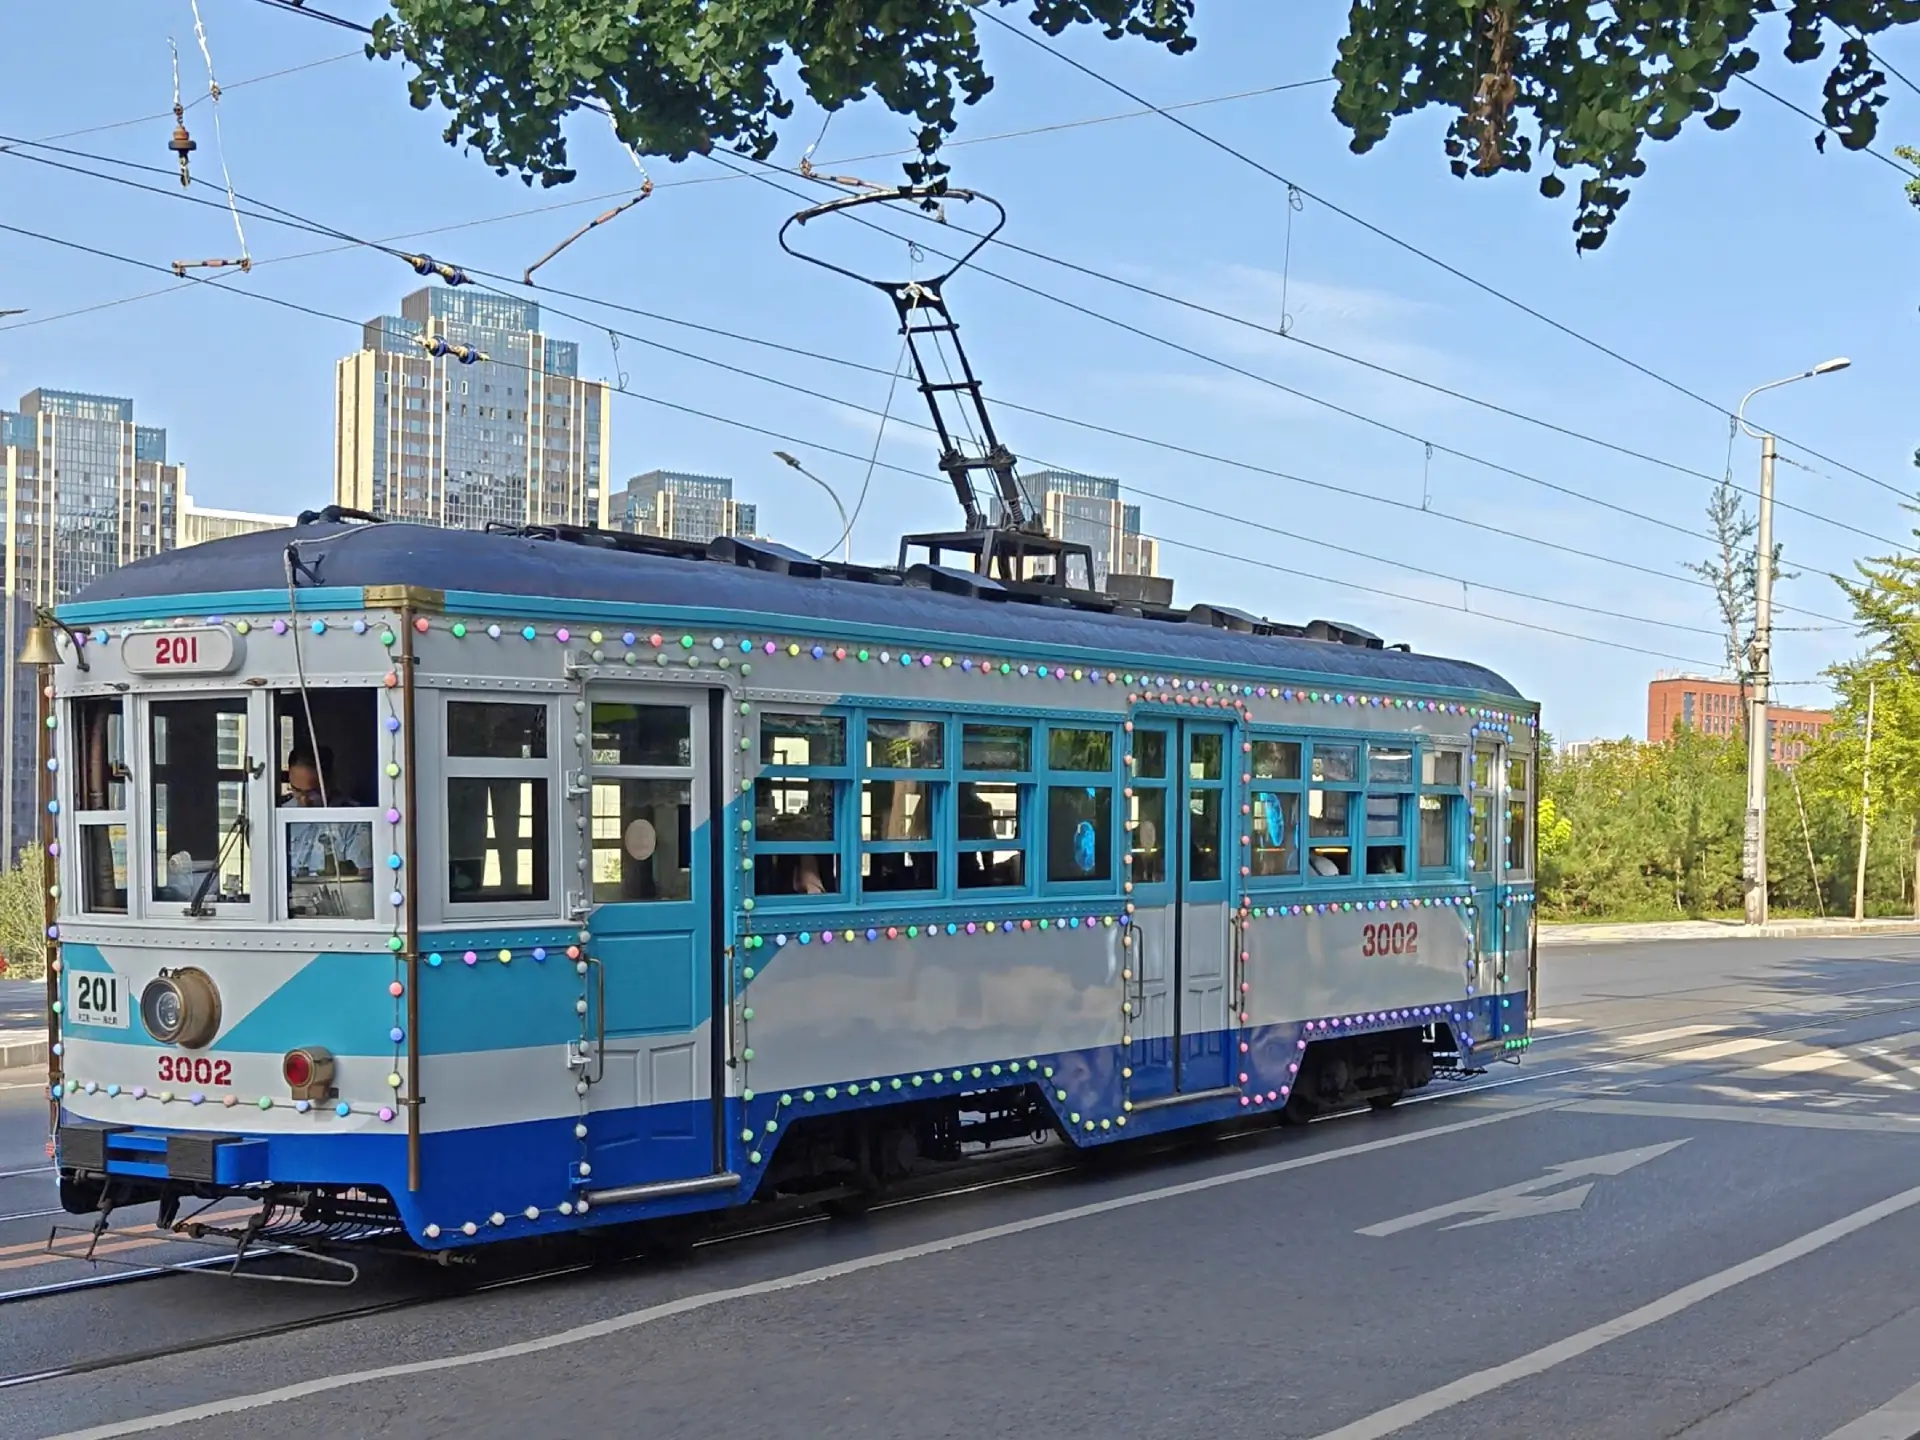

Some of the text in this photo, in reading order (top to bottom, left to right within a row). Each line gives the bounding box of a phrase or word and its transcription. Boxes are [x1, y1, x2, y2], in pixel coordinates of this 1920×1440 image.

[156, 637, 197, 664] 201
[1362, 921, 1418, 957] 3002
[78, 976, 117, 1012] 201
[158, 1055, 232, 1086] 3002
